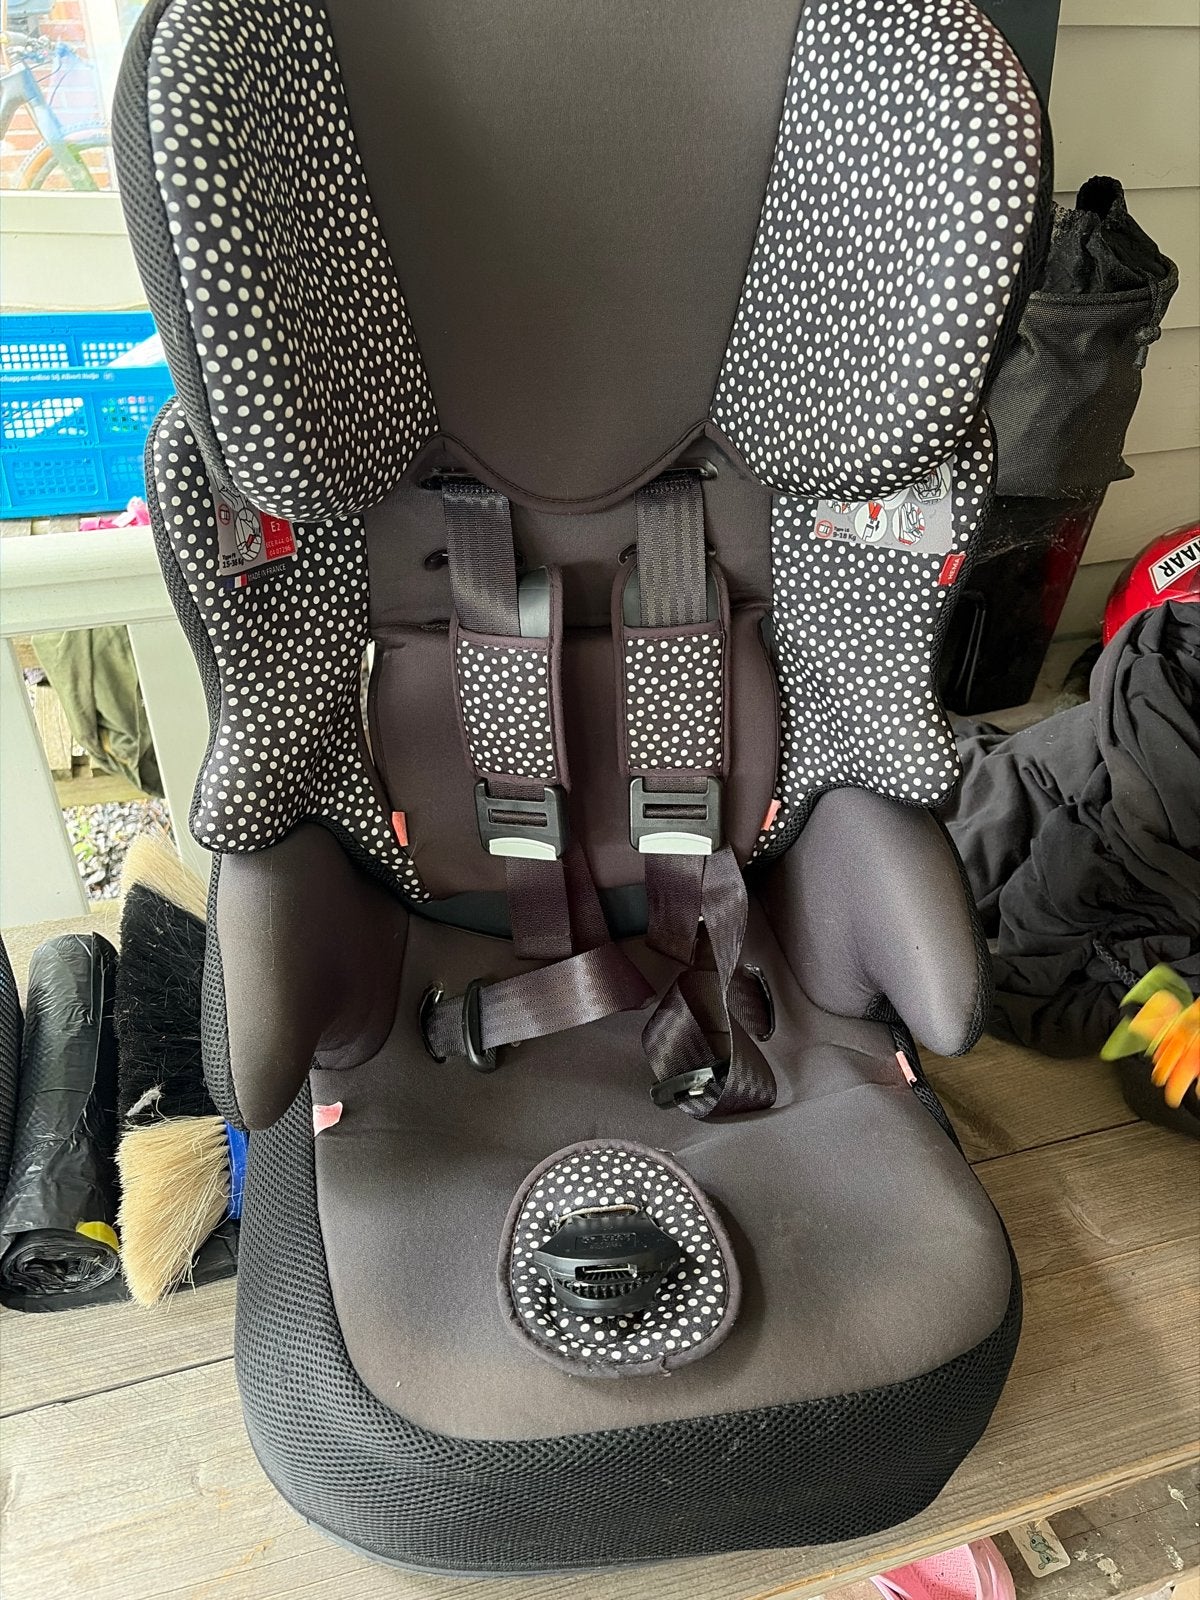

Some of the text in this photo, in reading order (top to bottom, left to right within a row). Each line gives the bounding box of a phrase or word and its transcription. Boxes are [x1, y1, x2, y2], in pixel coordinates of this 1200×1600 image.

[0, 375, 29, 383] chappen
[266, 563, 287, 575] FRANCE
[947, 557, 961, 580] HEMA
